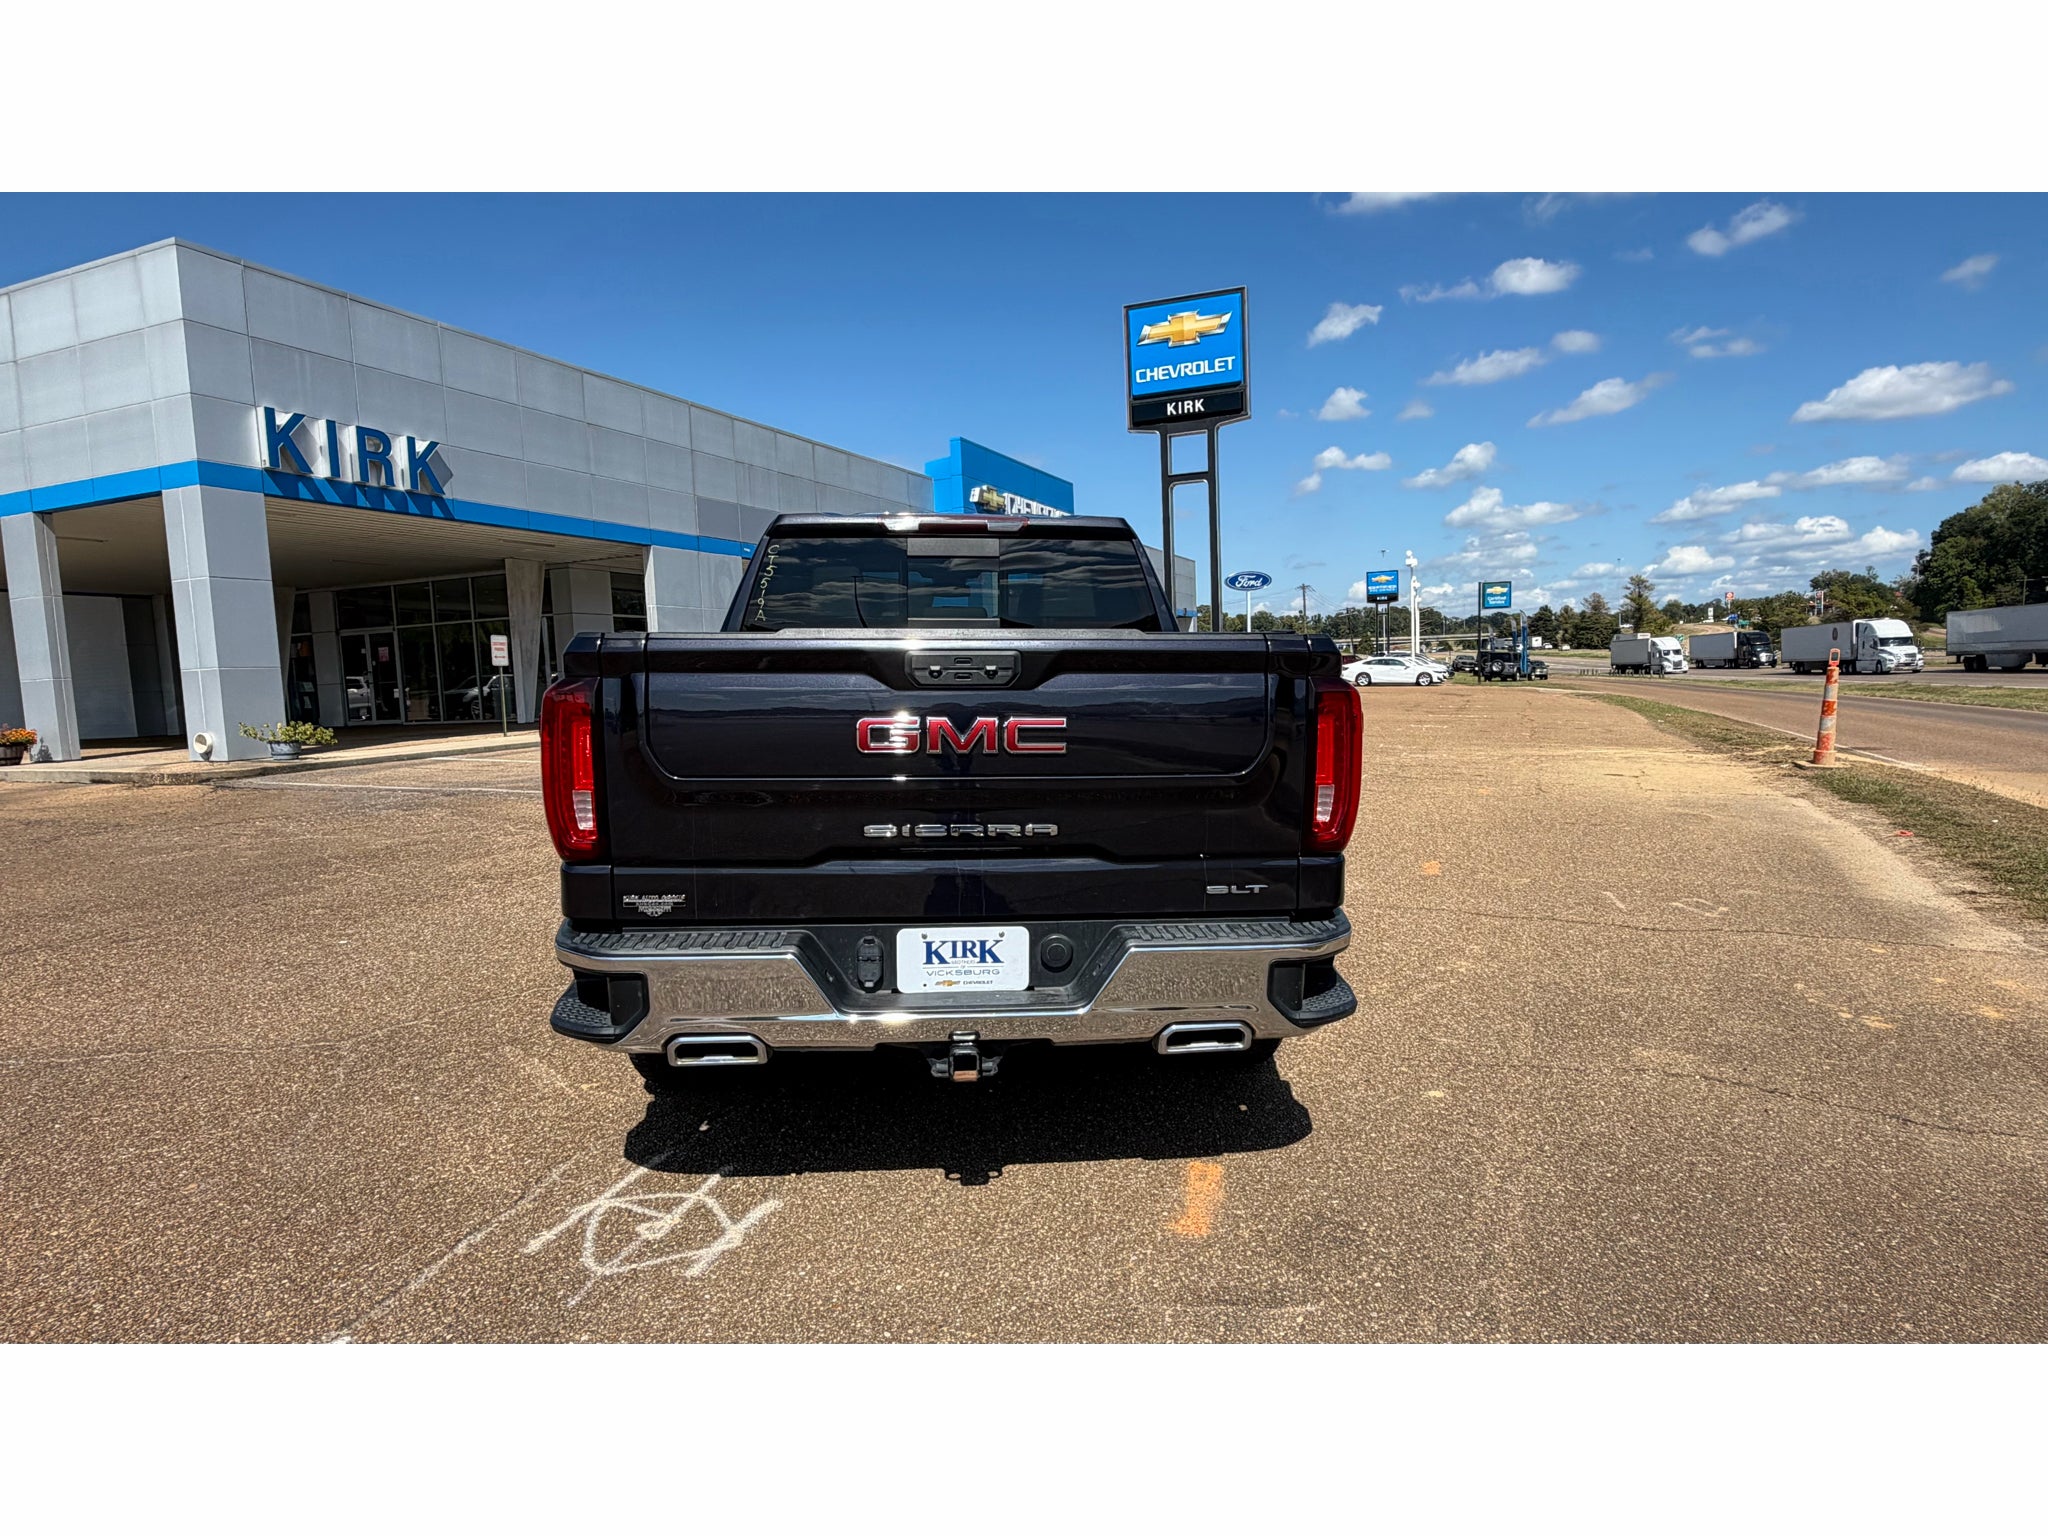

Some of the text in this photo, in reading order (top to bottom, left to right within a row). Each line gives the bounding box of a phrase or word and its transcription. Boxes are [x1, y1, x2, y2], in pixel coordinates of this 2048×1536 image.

[1135, 356, 1236, 383] CHEVROLET
[1166, 399, 1205, 416] KIRK
[260, 406, 445, 495] KIRK
[1235, 575, 1263, 587] Ford
[856, 716, 1067, 754] GMC
[863, 824, 1059, 837] SIERRA
[1206, 884, 1269, 895] SLT
[923, 940, 1005, 965] KIRK
